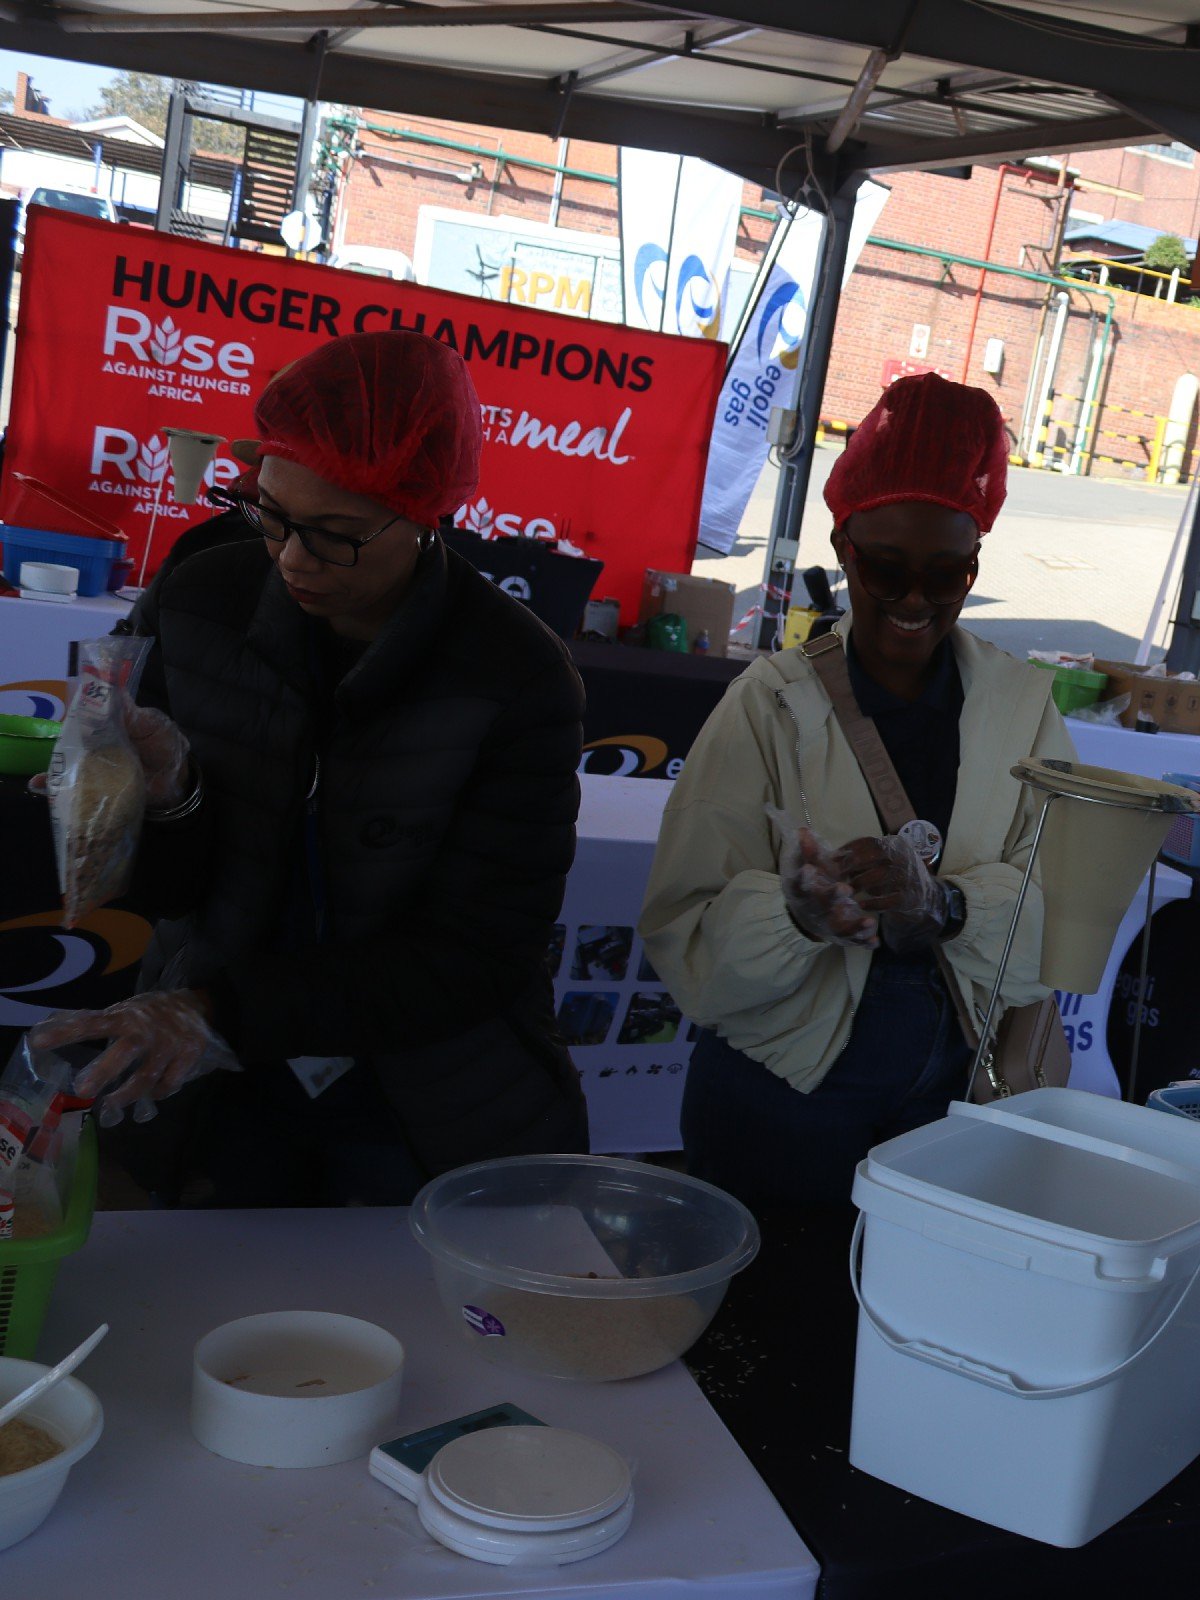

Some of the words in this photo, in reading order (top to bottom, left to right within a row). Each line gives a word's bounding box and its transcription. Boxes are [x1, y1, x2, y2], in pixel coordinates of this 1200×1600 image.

[499, 265, 591, 313] RPM
[112, 255, 341, 337] HUNGER
[353, 304, 656, 393] CHAMPIONS
[101, 360, 177, 384] AGAINST
[180, 373, 251, 397] HUNGER
[147, 384, 204, 405] AFRICA
[724, 377, 750, 427] gas
[746, 365, 781, 431] egoli
[510, 406, 632, 465] meal
[89, 480, 163, 500] AGAINST
[133, 502, 190, 520] AFRICA
